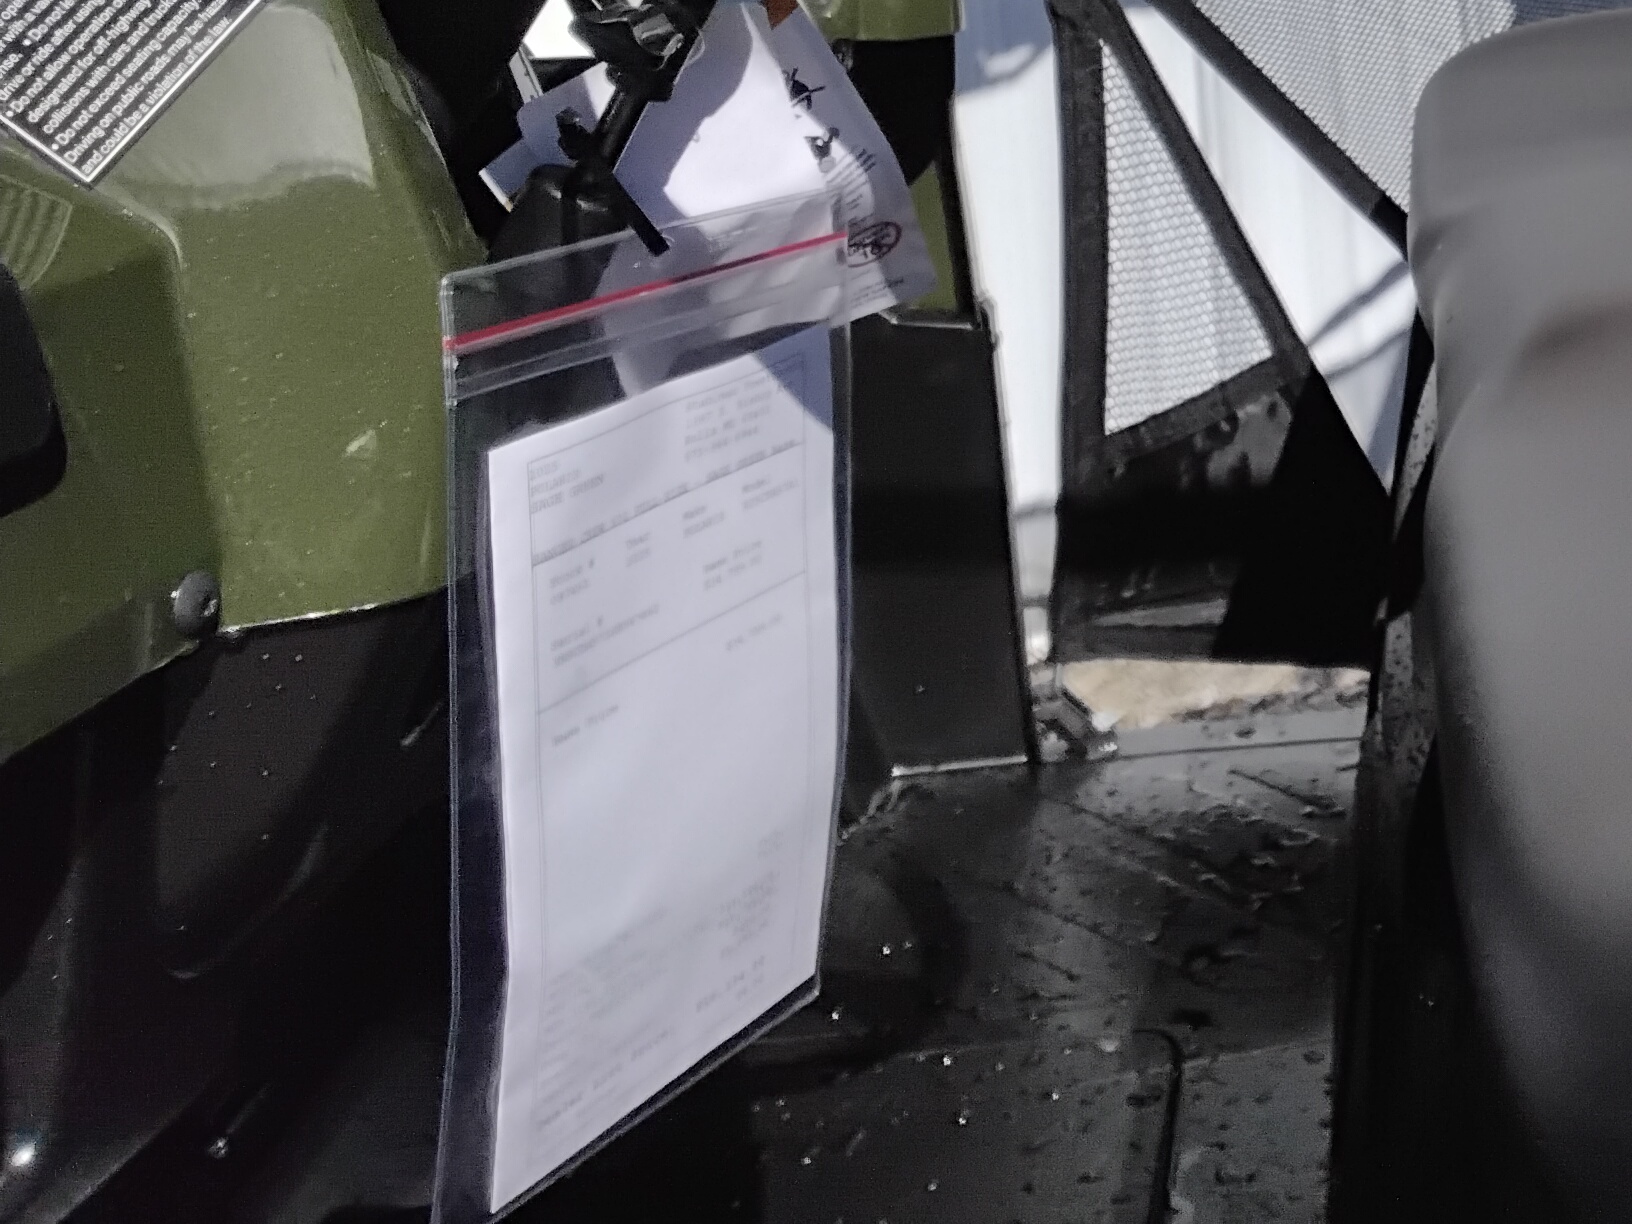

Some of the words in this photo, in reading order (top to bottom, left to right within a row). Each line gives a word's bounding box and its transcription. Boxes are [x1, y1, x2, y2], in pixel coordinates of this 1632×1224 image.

[0, 74, 25, 102] drive
[21, 61, 36, 76] or
[31, 43, 55, 66] ride
[50, 18, 77, 46] after
[1, 19, 29, 42] with
[23, 12, 37, 23] a
[8, 95, 31, 114] Do
[25, 77, 48, 99] not
[42, 51, 72, 81] allow
[67, 6, 117, 55] operation
[27, 23, 49, 42] Do
[44, 5, 67, 26] not
[27, 64, 84, 123] designated
[76, 51, 97, 70] for
[42, 86, 91, 134] collisions
[84, 65, 112, 88] with
[106, 43, 132, 67] cars
[126, 21, 150, 47] and
[54, 128, 76, 146] Do
[71, 109, 94, 131] not
[88, 72, 127, 114] exceed
[121, 39, 163, 78] seating
[62, 125, 106, 165] Driving
[99, 112, 116, 128] on
[111, 81, 145, 117] public
[140, 53, 172, 85] roads
[166, 31, 192, 57] may
[184, 19, 204, 36] be
[81, 149, 105, 176] and
[99, 121, 131, 155] could
[123, 110, 143, 128] be
[138, 103, 151, 113] a
[145, 62, 189, 106] violation
[184, 48, 199, 65] of
[192, 35, 214, 54] the
[207, 16, 233, 39] law.
